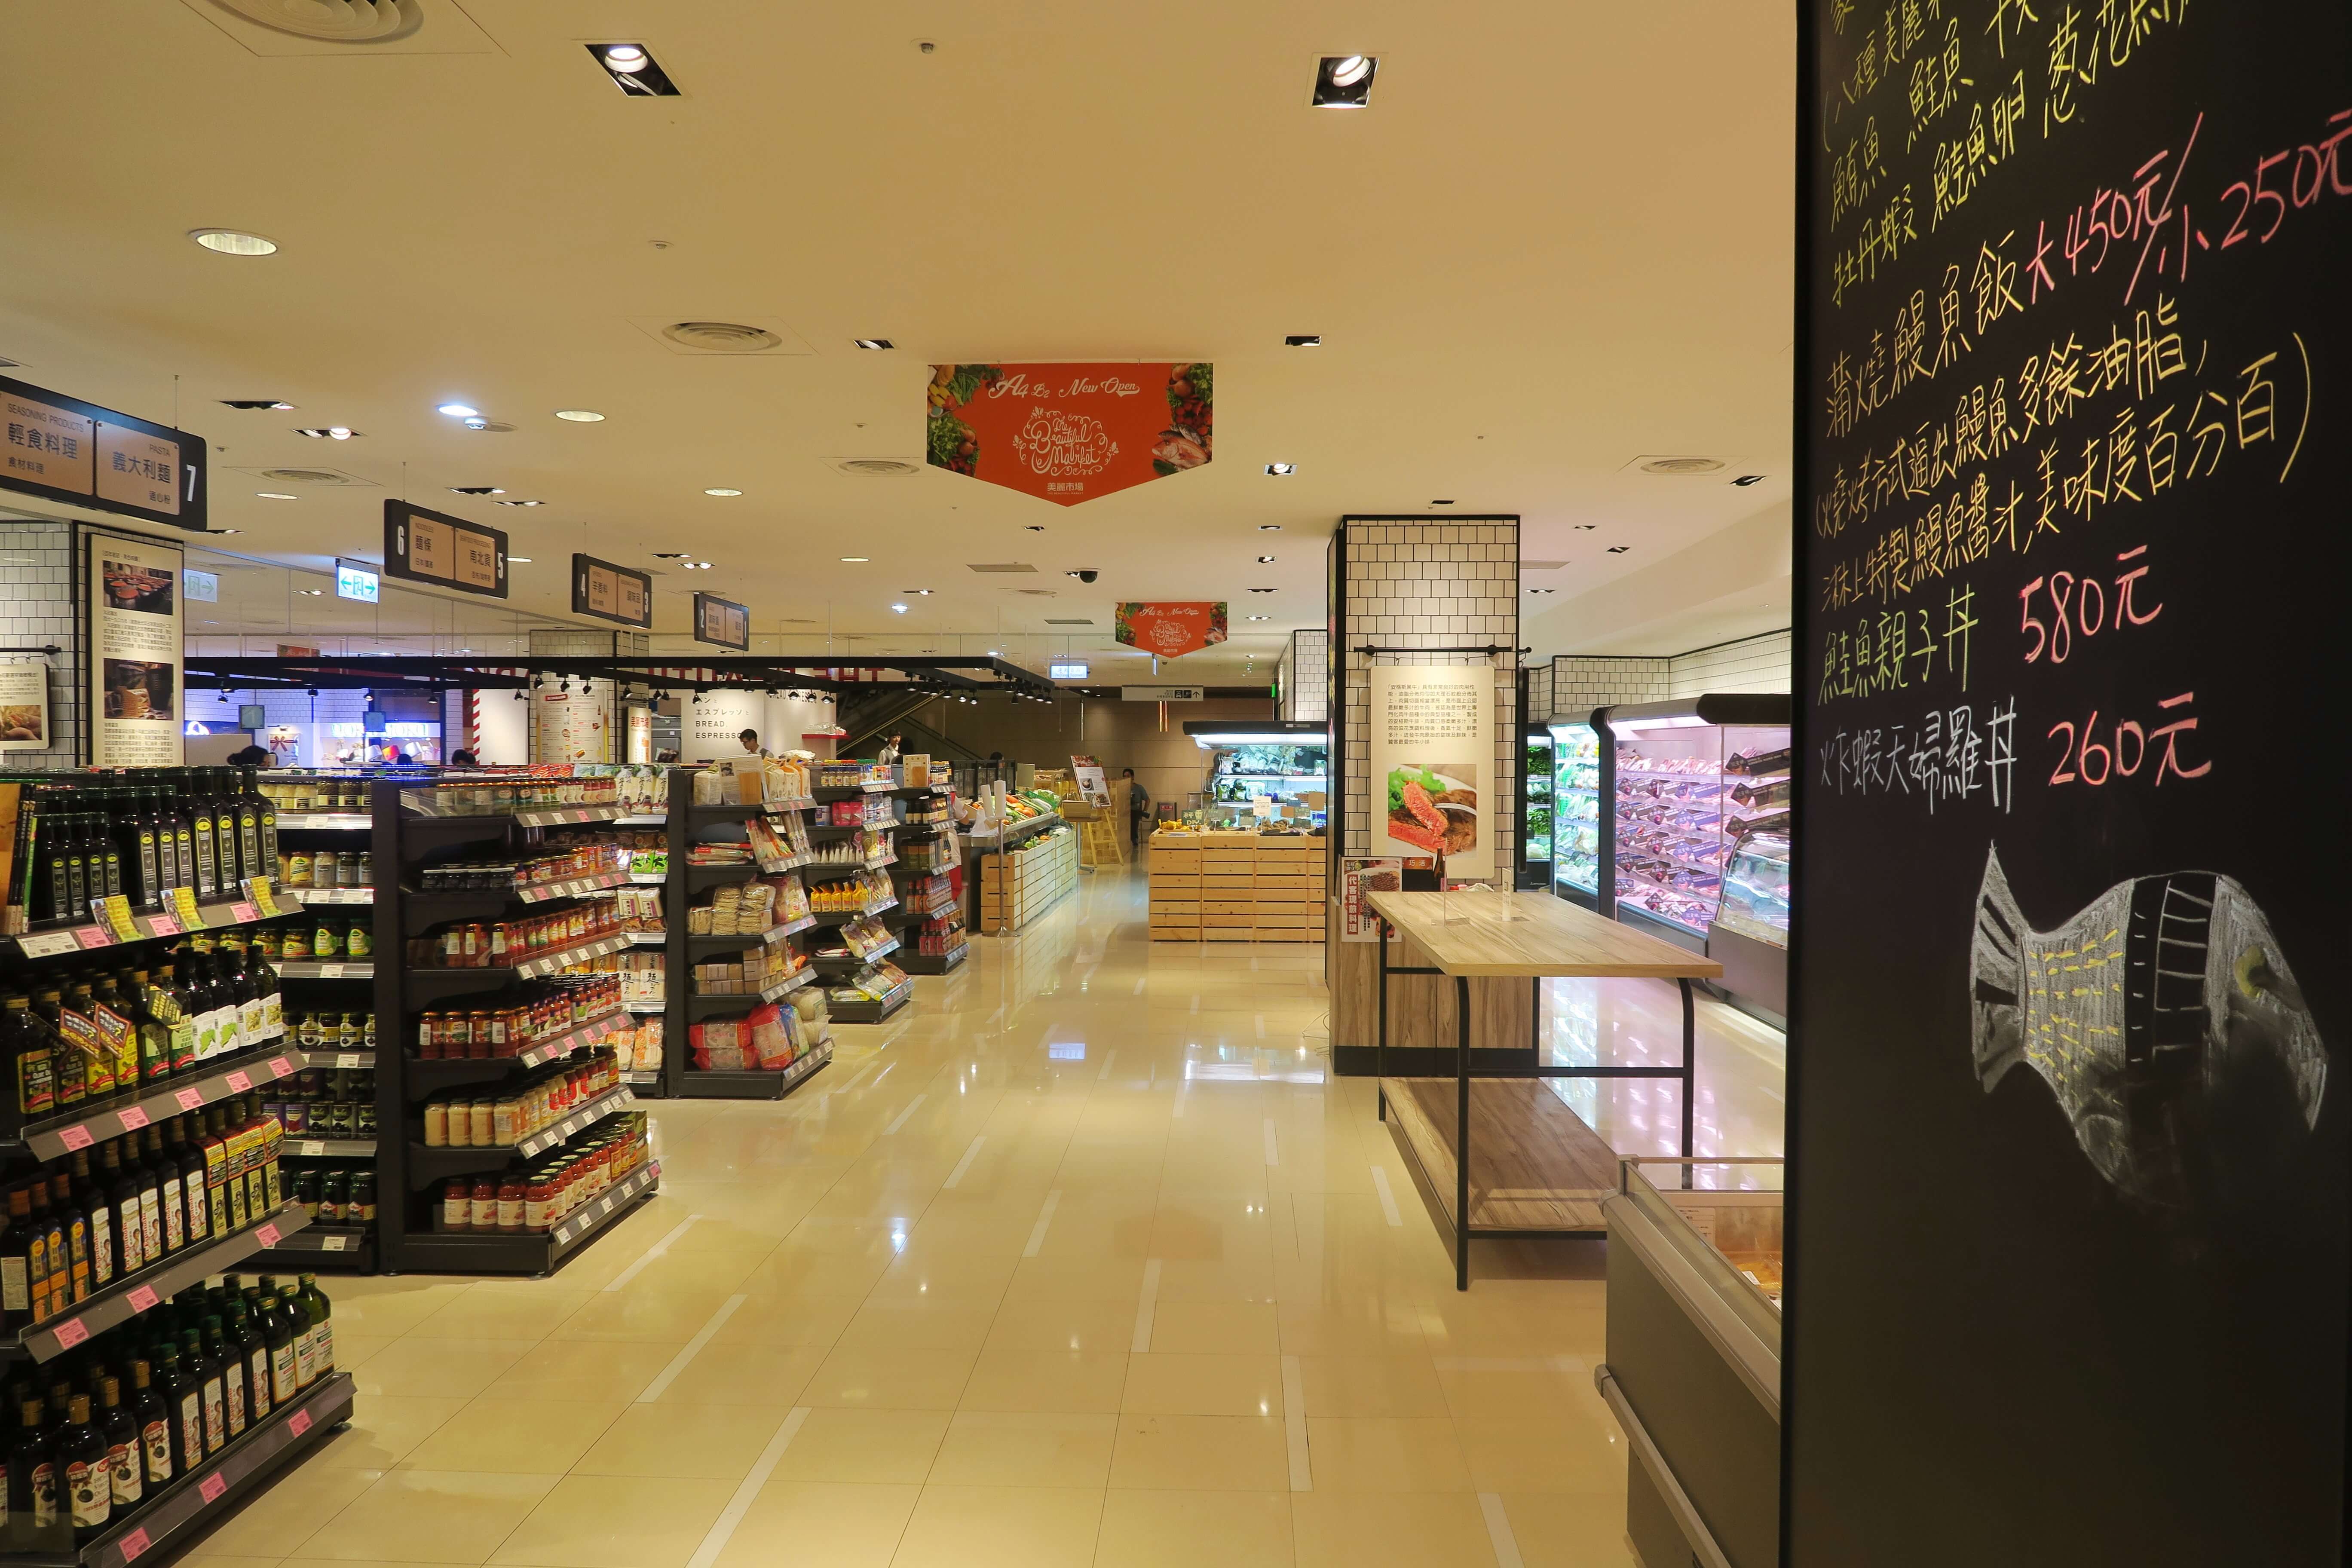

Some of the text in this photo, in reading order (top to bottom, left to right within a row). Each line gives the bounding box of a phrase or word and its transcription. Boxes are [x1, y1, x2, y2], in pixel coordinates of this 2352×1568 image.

[1058, 378, 1098, 398] New
[1100, 377, 1140, 398] Open
[8, 403, 84, 432] SEASONING PRODUCTS
[8, 422, 78, 459] 輕食料理
[1030, 420, 1092, 453] Beautiful
[186, 464, 196, 502] 7
[1047, 482, 1084, 491] 美麗市場
[398, 525, 404, 555] 6
[497, 552, 504, 579] 5
[581, 574, 585, 597] 4
[1817, 545, 2163, 706] 鮭魚親子丼 580元
[2049, 691, 2212, 787] 260元
